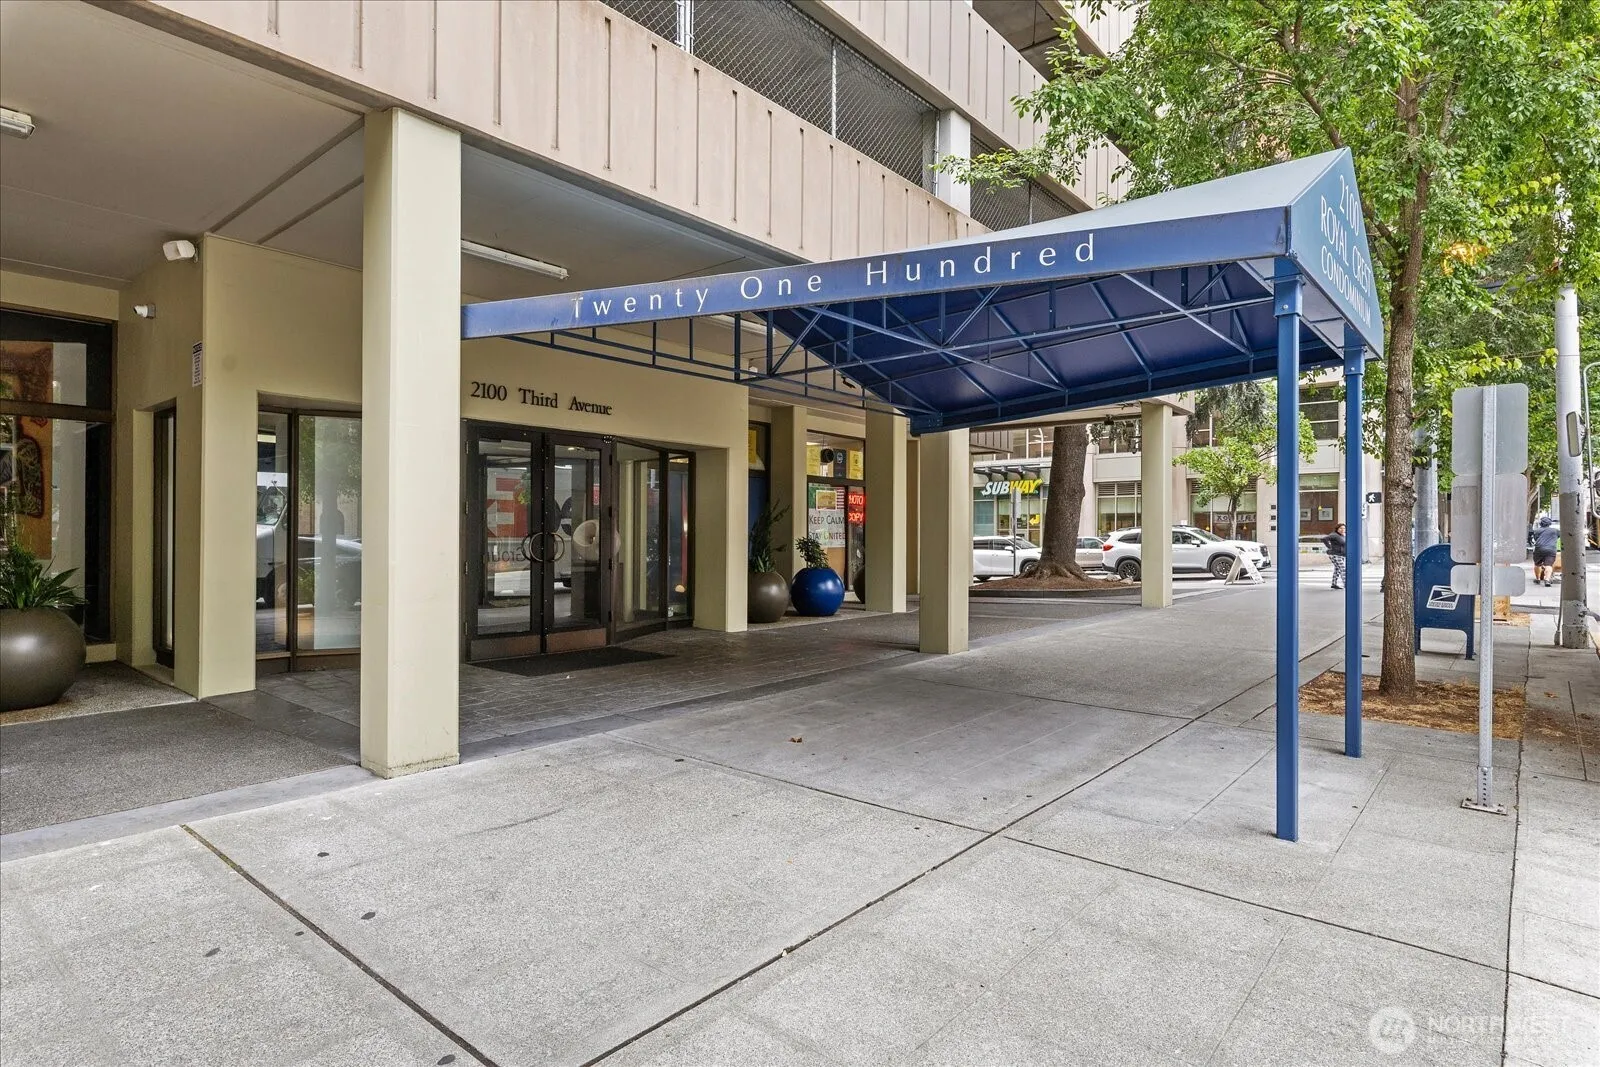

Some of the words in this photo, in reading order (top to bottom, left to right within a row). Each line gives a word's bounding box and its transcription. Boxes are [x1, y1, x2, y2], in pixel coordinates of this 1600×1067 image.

[1339, 174, 1360, 237] 2100
[1320, 195, 1350, 266] ROYAL
[1352, 245, 1372, 297] CREST
[571, 287, 710, 318] Twenty
[740, 274, 822, 300] One
[865, 233, 1095, 286] Hundred
[1321, 245, 1372, 328] CONDOMINIUM
[470, 381, 508, 402] 2100
[518, 387, 559, 409] Third
[568, 395, 613, 417] Avenue
[848, 495, 864, 505] HOTO
[981, 479, 1043, 496] SUBWAY
[809, 515, 825, 524] KEEP
[826, 514, 845, 524] CALM
